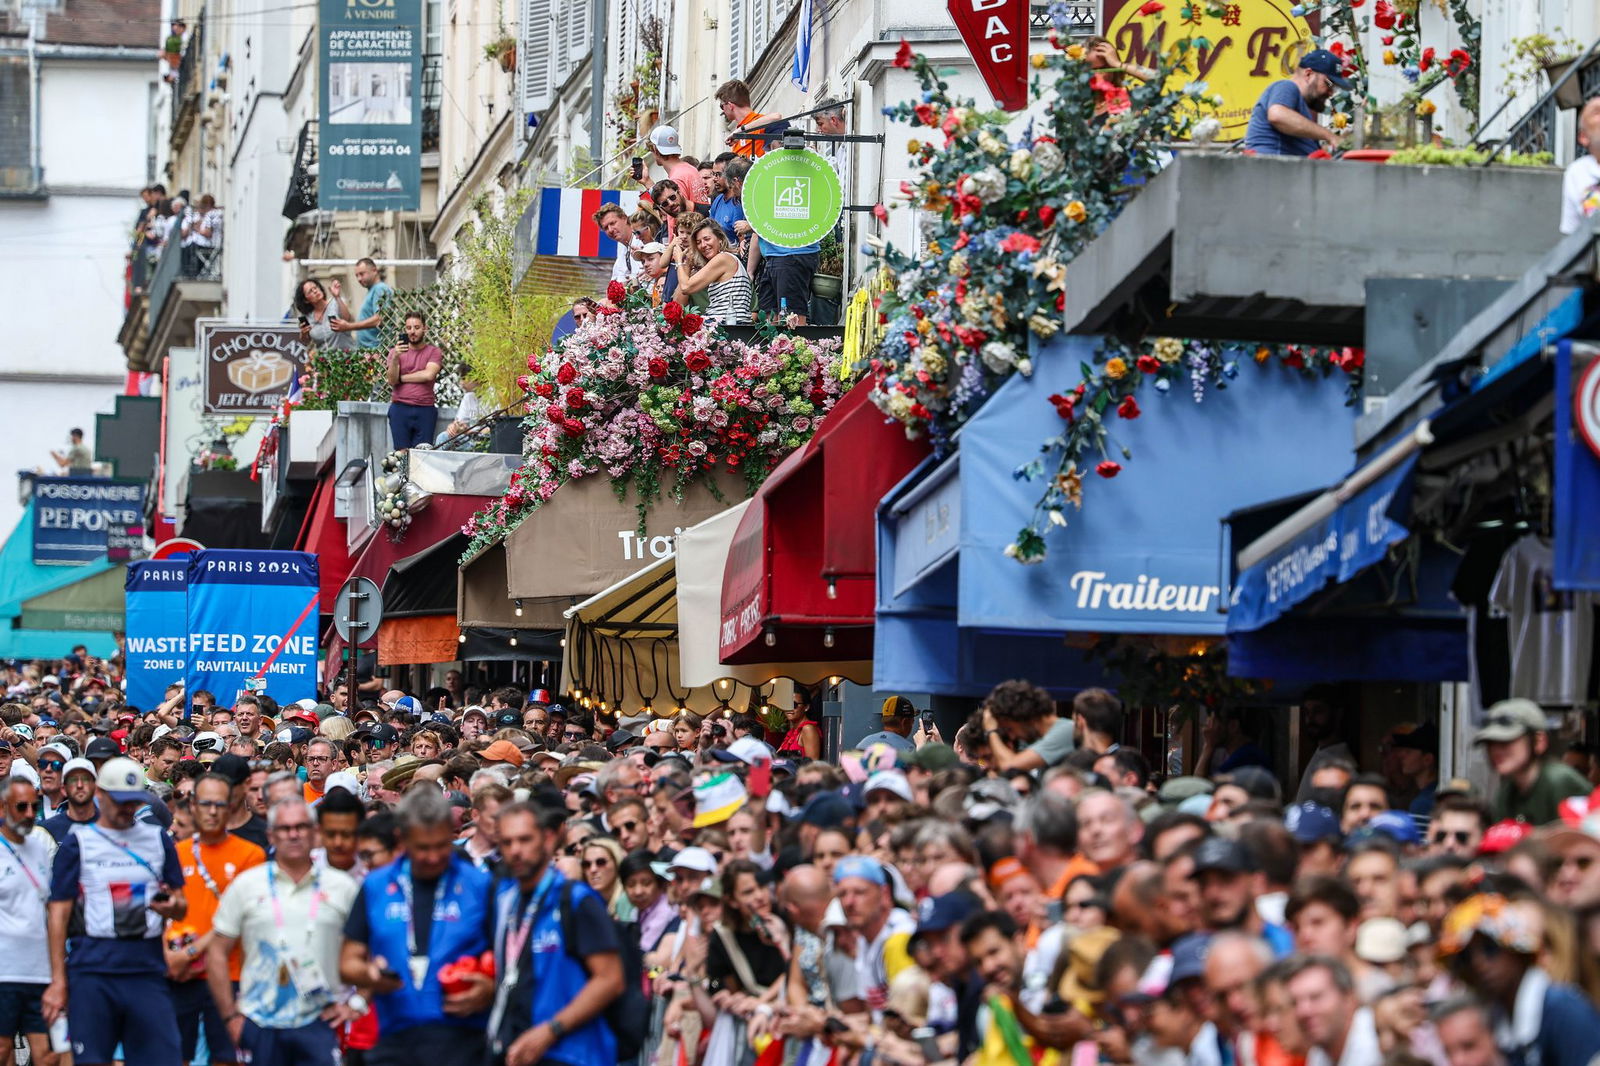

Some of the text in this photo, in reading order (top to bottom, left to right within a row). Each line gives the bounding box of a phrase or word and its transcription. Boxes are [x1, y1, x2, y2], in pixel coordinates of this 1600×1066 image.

[354, 9, 398, 20] VENDRE
[329, 30, 412, 40] APPARTEMENTS
[329, 40, 344, 50] DE
[328, 145, 411, 155] 06 95 80 24 04
[763, 155, 822, 171] BOULANGERIE BIO
[777, 186, 804, 206] AB
[763, 221, 820, 239] BOULANGERIE BIO
[212, 332, 310, 364] CHOCOLATS
[215, 393, 247, 409] JEFF
[207, 560, 300, 574] PARIS 2024
[143, 570, 185, 582] PARIS
[1069, 570, 1220, 613] Traiteur
[126, 636, 187, 653] WASTE
[189, 633, 316, 656] FEED ZONE
[143, 659, 175, 670] ZONE
[195, 660, 307, 675] RAVITAILLMENT
